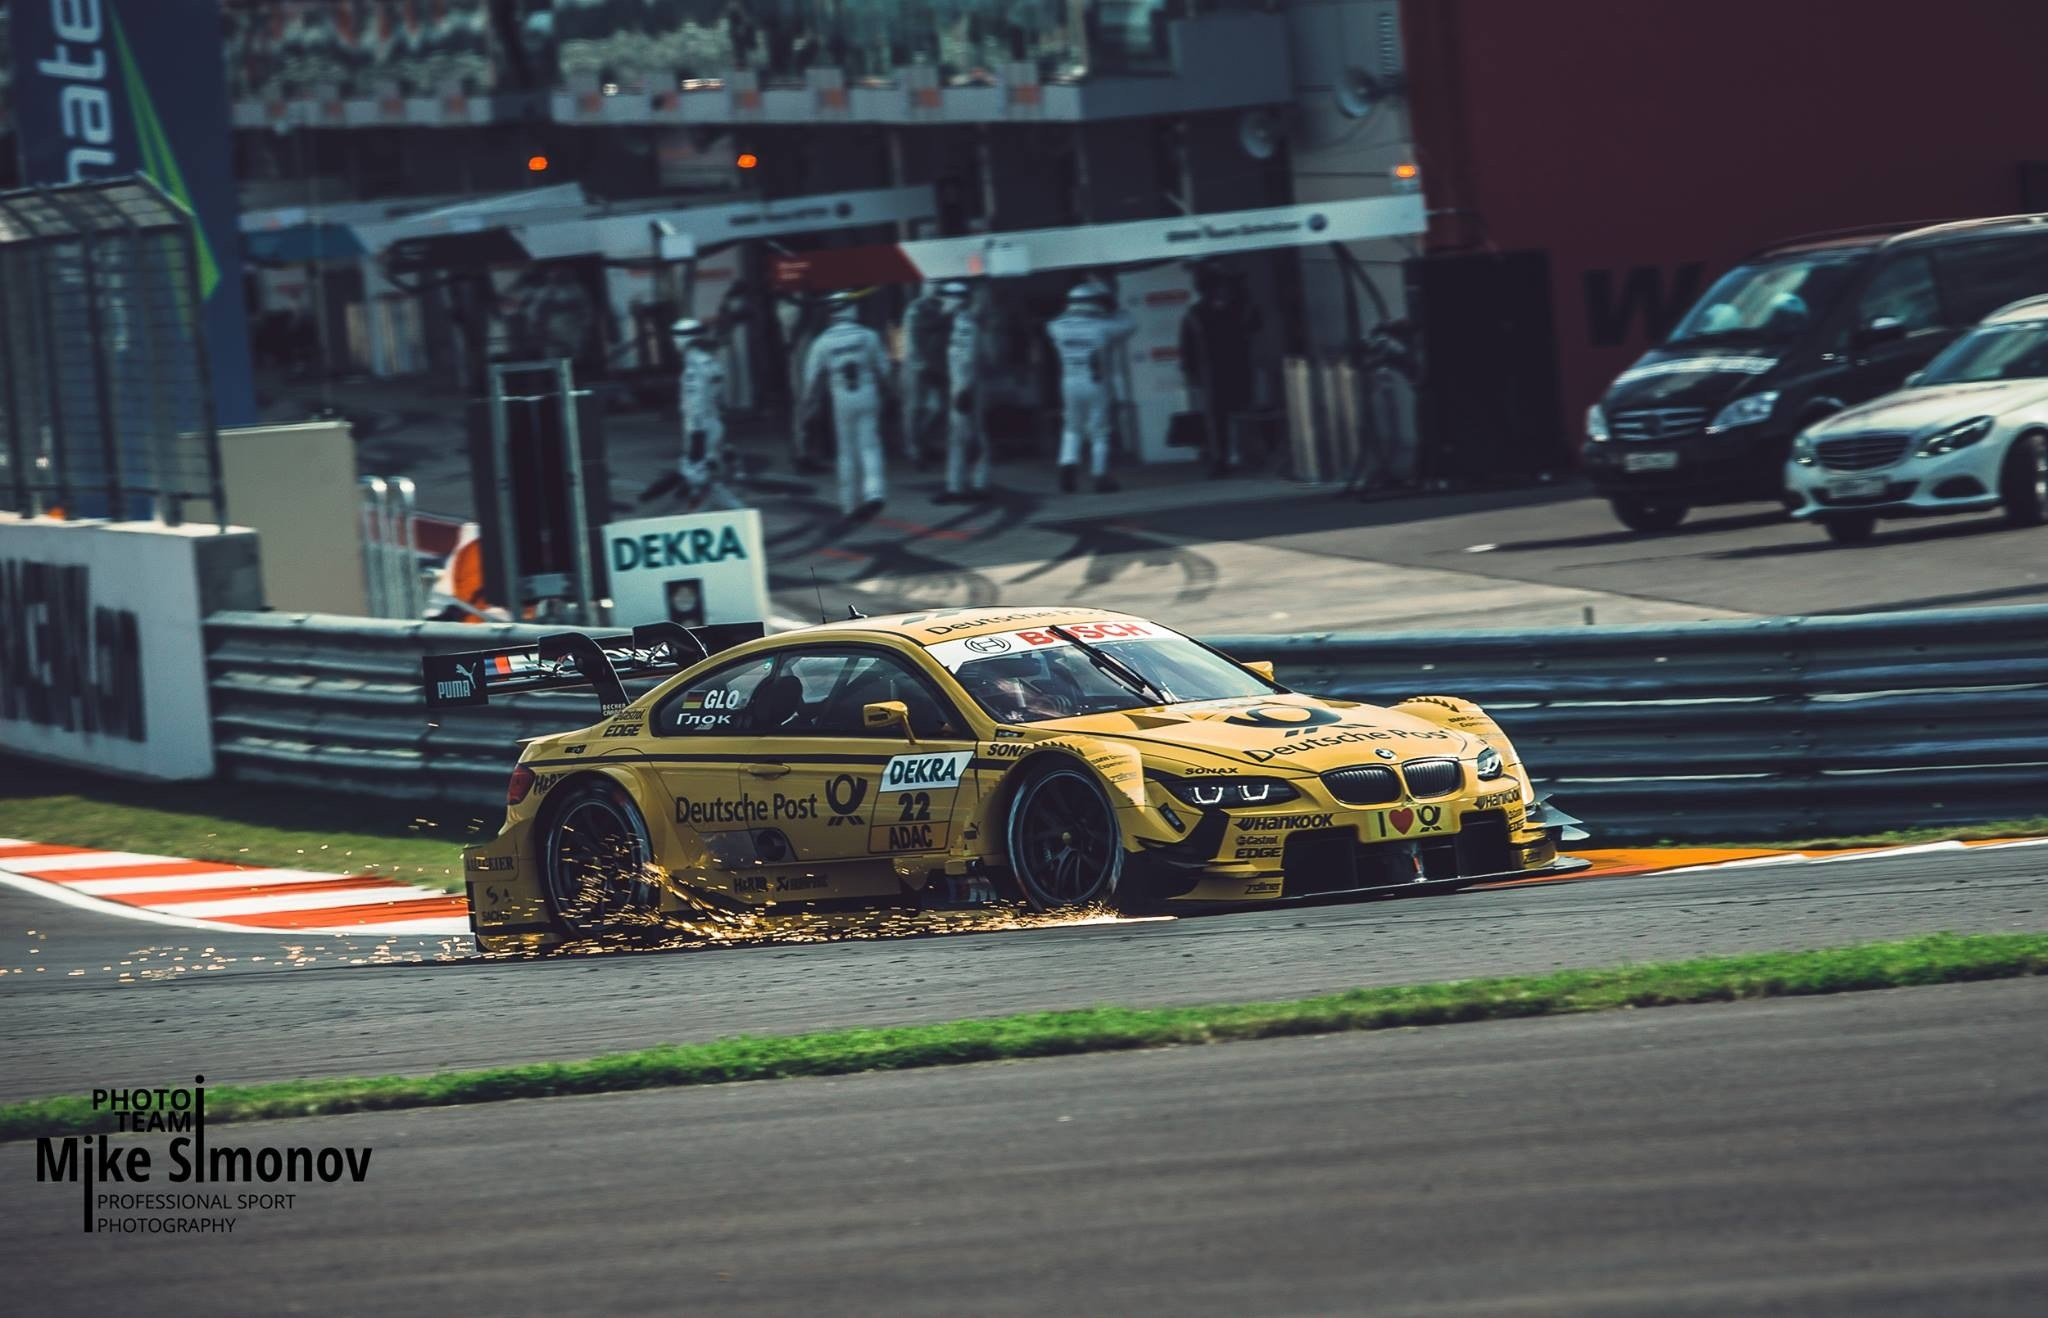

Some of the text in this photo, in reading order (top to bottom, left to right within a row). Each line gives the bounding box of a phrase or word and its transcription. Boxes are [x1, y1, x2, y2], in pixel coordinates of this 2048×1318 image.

[612, 525, 748, 572] DEKRA
[1015, 622, 1152, 646] BOSCH
[437, 680, 471, 699] PUMA
[602, 723, 644, 737] EDGE
[676, 713, 732, 726] Глок
[1243, 728, 1451, 763] Deutsche Post
[889, 757, 957, 785] DEKRA
[1185, 767, 1239, 776] SONAX
[675, 793, 818, 824] Deutsche Post
[898, 791, 931, 822] 22
[889, 824, 933, 849] ADAC
[1235, 847, 1283, 859] EDGE
